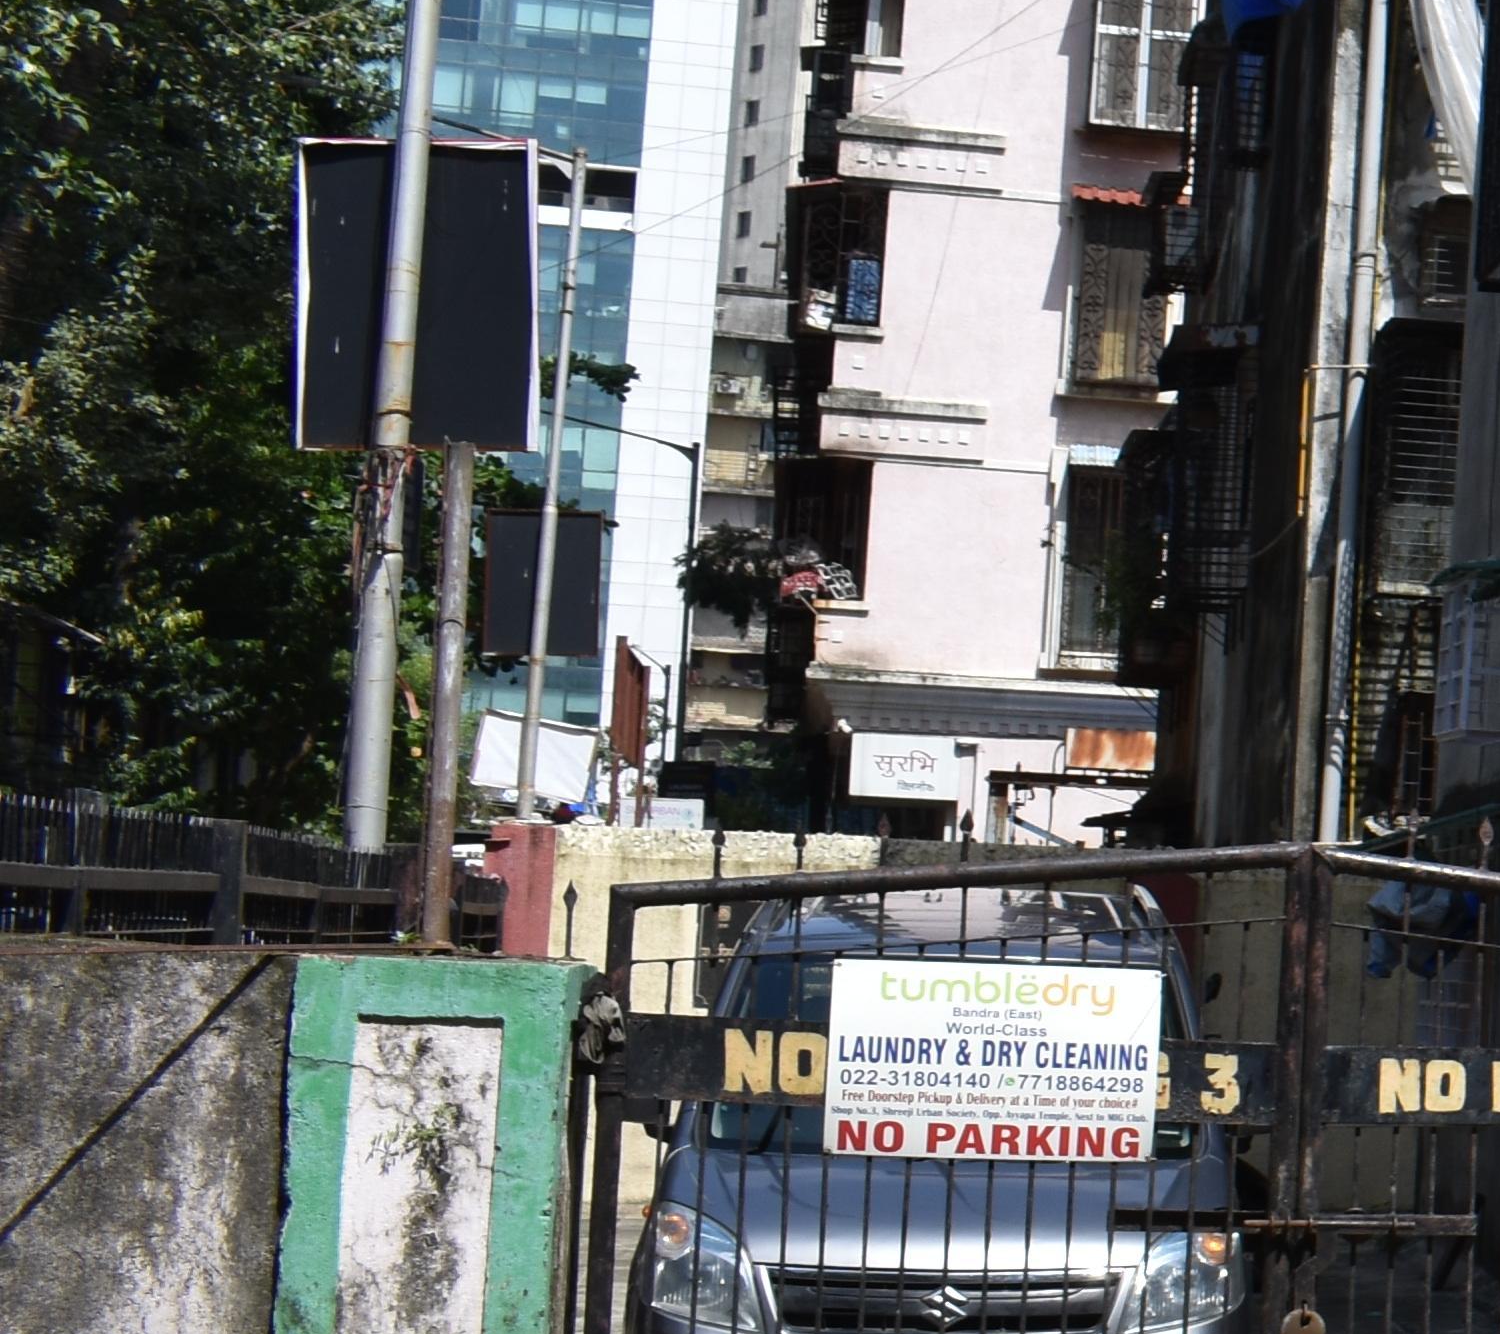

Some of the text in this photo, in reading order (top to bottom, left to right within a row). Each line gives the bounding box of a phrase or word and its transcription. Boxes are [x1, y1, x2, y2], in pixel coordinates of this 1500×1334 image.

[872, 749, 938, 778] सुरभि
[881, 970, 1115, 1016] tumblëdry
[945, 1021, 1047, 1037] World-Class
[952, 1007, 1042, 1021] Bandra (East)
[722, 1028, 828, 1095] NO
[838, 1035, 1149, 1071] LAUNDRY & DRY CLEANING
[840, 1069, 991, 1088] 022-31804140
[1201, 1053, 1240, 1115] 3
[1378, 1058, 1467, 1114] NO
[842, 1089, 865, 1102] Free
[868, 1090, 915, 1105] Doorstep
[918, 1091, 953, 1106] Pickup
[956, 1093, 963, 1105] &
[966, 1093, 1006, 1108] Delivery
[1010, 1095, 1020, 1106] at
[1033, 1095, 1057, 1107] Time
[1060, 1095, 1070, 1107] of
[1073, 1098, 1096, 1110] your
[836, 1120, 1140, 1158] NO PARKING
